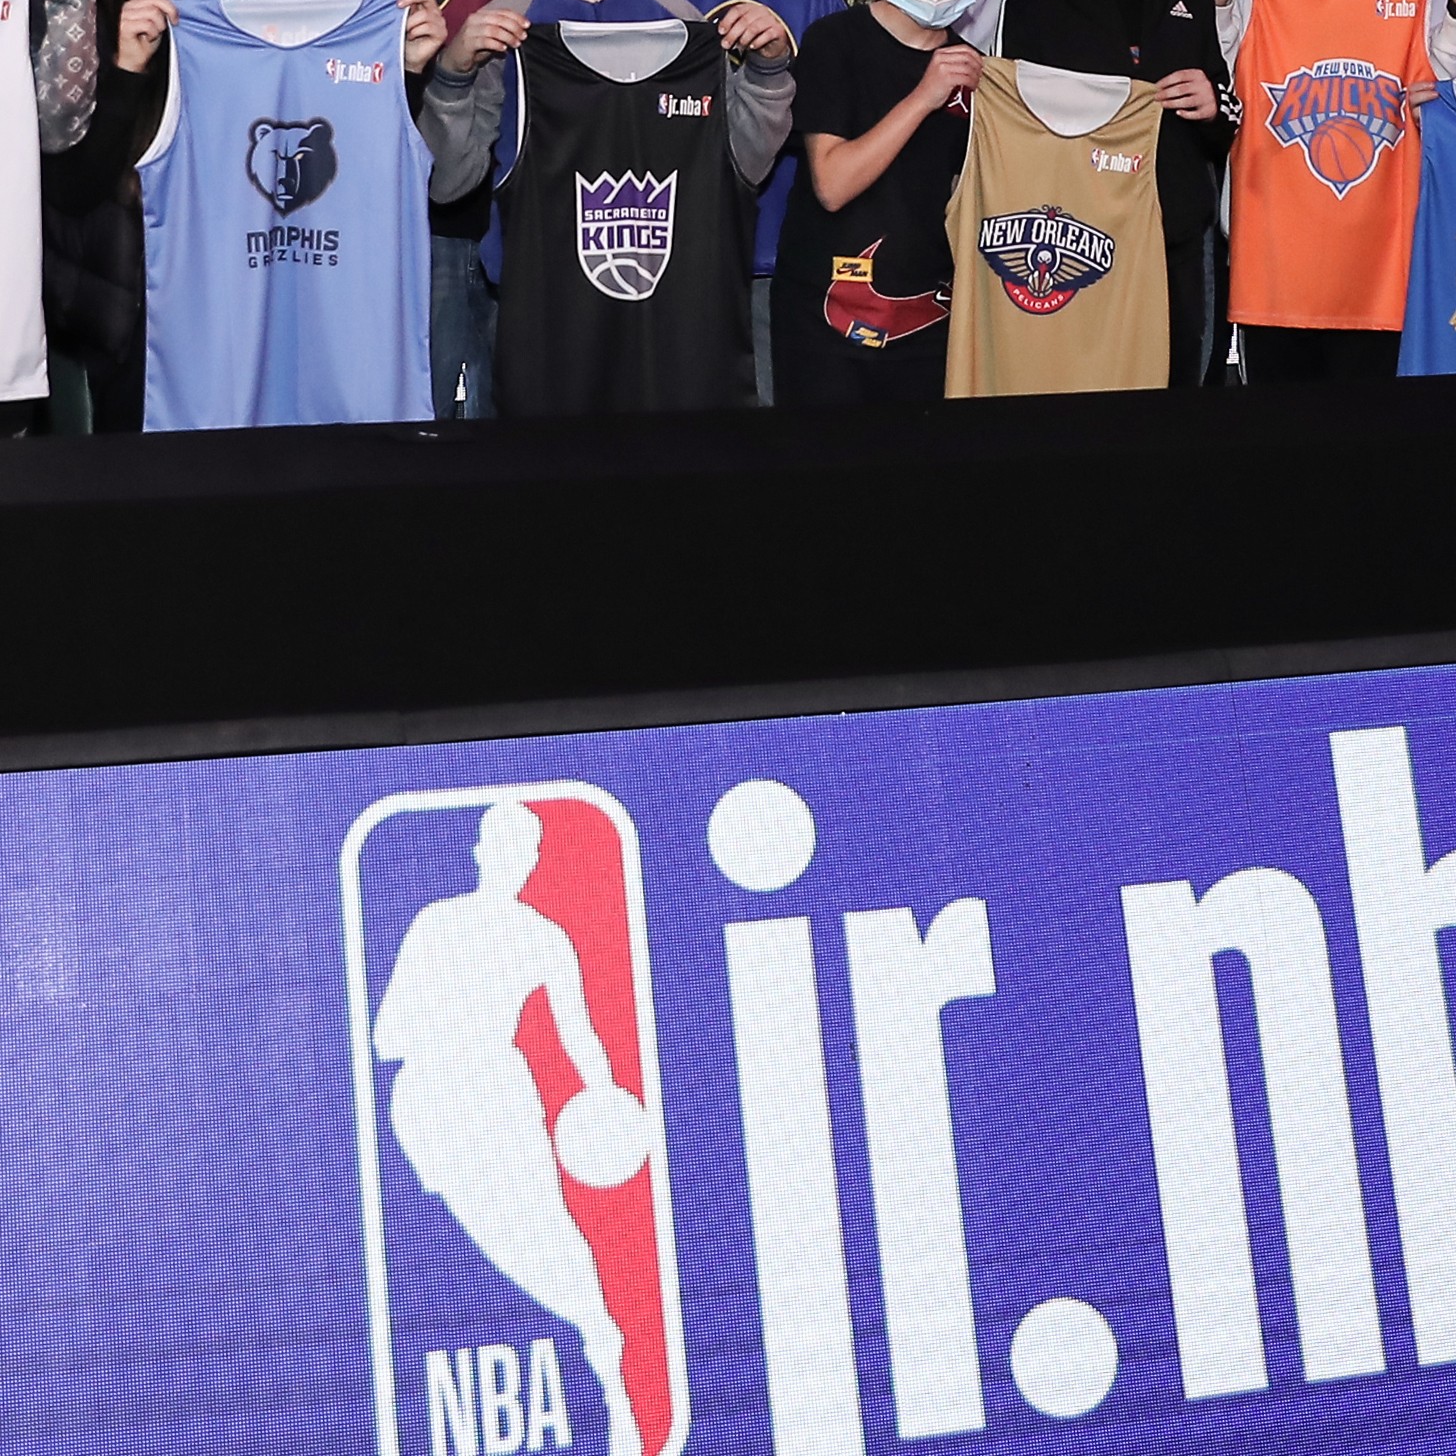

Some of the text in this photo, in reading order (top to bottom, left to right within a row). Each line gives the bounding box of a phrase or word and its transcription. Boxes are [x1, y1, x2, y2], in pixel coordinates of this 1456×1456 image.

[1383, 0, 1416, 19] jr.nba
[1314, 62, 1374, 77] NEW YORK
[667, 95, 701, 118] jr.nba
[1271, 75, 1405, 129] KNICKS
[1097, 150, 1131, 173] jr.nba
[247, 226, 340, 253] MMPHIS
[582, 224, 668, 250] KINGS
[980, 218, 1115, 269] NEW ORLEANS
[248, 248, 339, 268] GRZLIES
[1013, 288, 1065, 309] PELICANS
[424, 1337, 574, 1456] NBA
